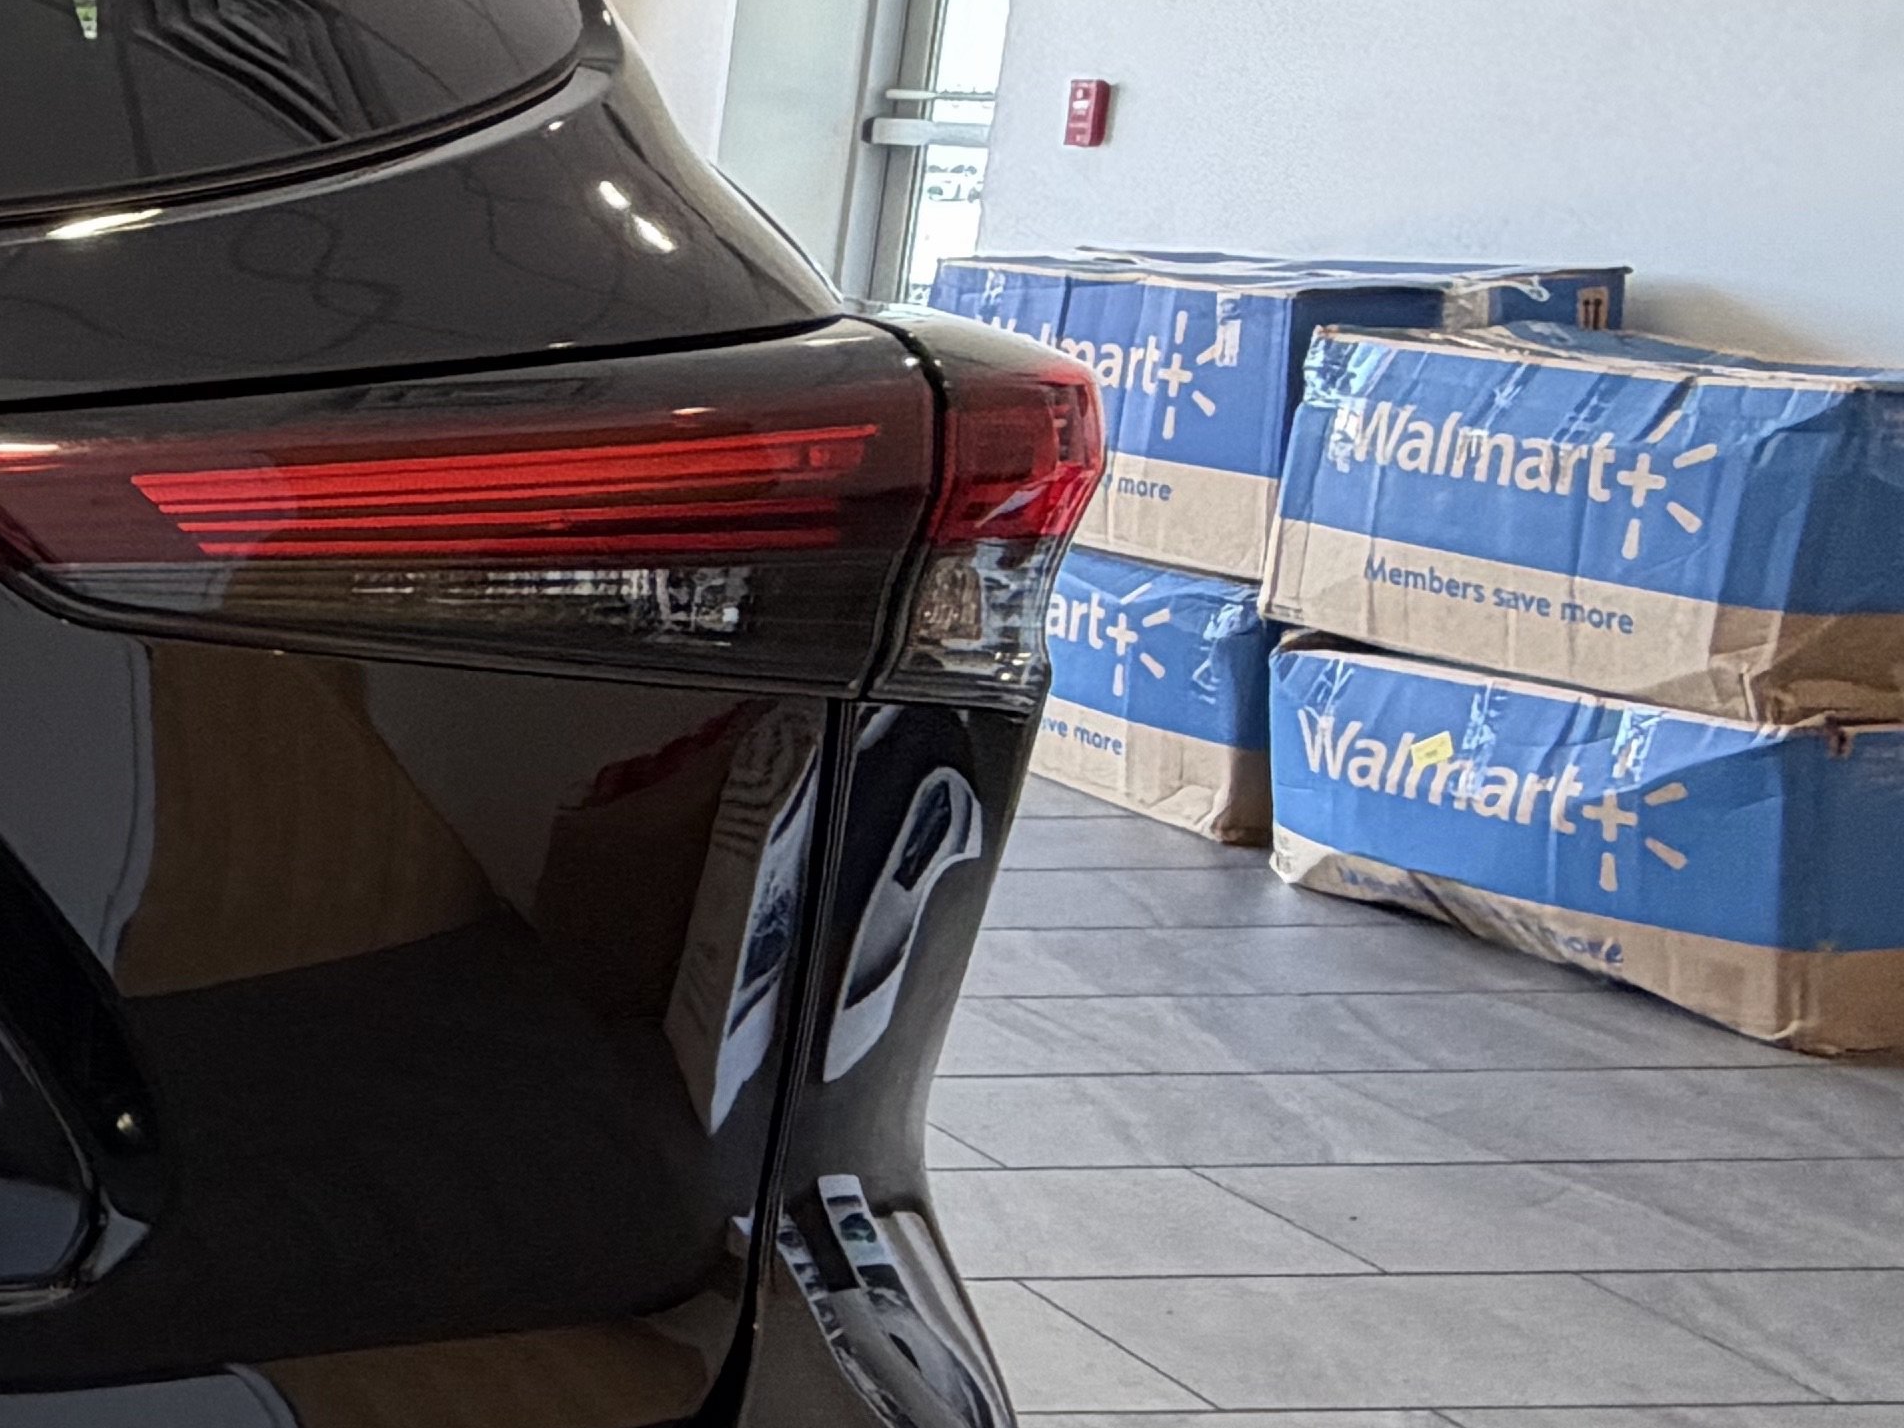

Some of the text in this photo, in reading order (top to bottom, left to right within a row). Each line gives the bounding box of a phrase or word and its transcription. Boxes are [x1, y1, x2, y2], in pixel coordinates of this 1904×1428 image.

[1116, 474, 1173, 503] more
[1364, 555, 1635, 636] Members save more
[1073, 725, 1123, 756] more
